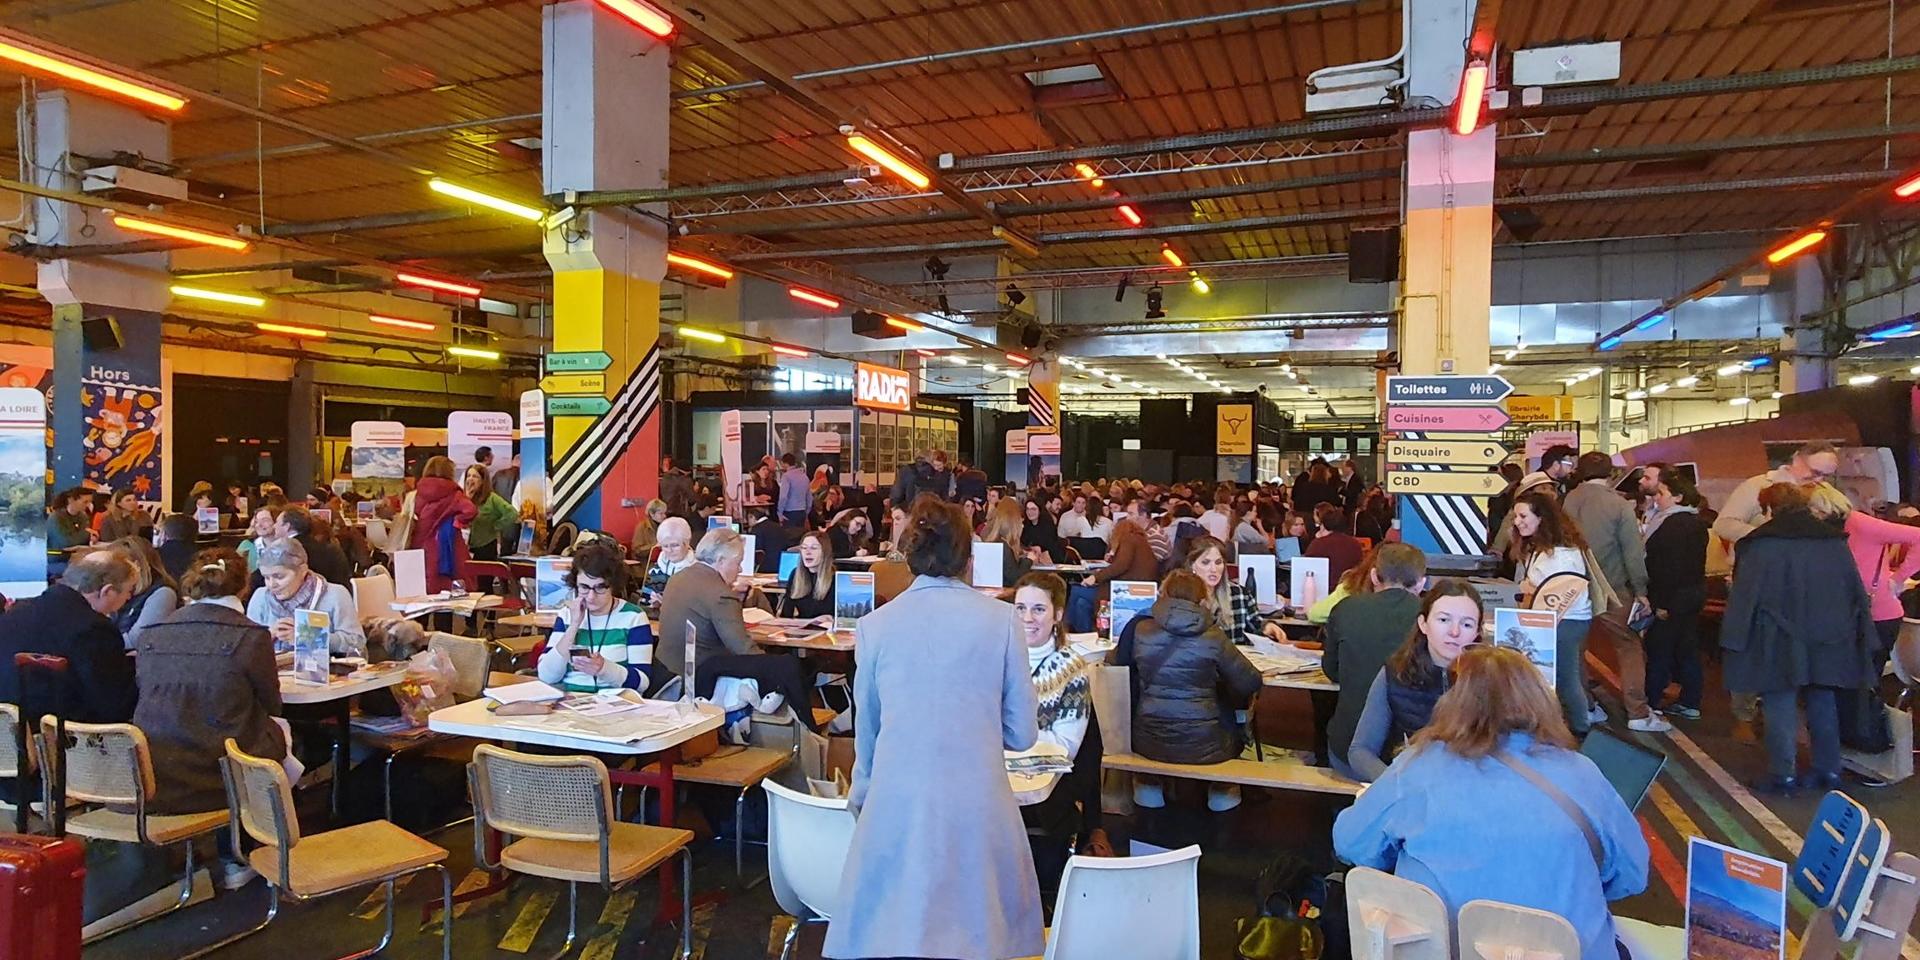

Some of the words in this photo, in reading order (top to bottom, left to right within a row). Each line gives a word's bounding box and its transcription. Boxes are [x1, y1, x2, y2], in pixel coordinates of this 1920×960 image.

[90, 365, 130, 381] Hors
[580, 379, 600, 387] Scène
[1394, 384, 1447, 394] Toilettes
[550, 402, 581, 410] Cocktails
[1393, 414, 1444, 423] Cuisines
[1393, 446, 1451, 458] Disquaire
[1393, 476, 1420, 486] CBD
